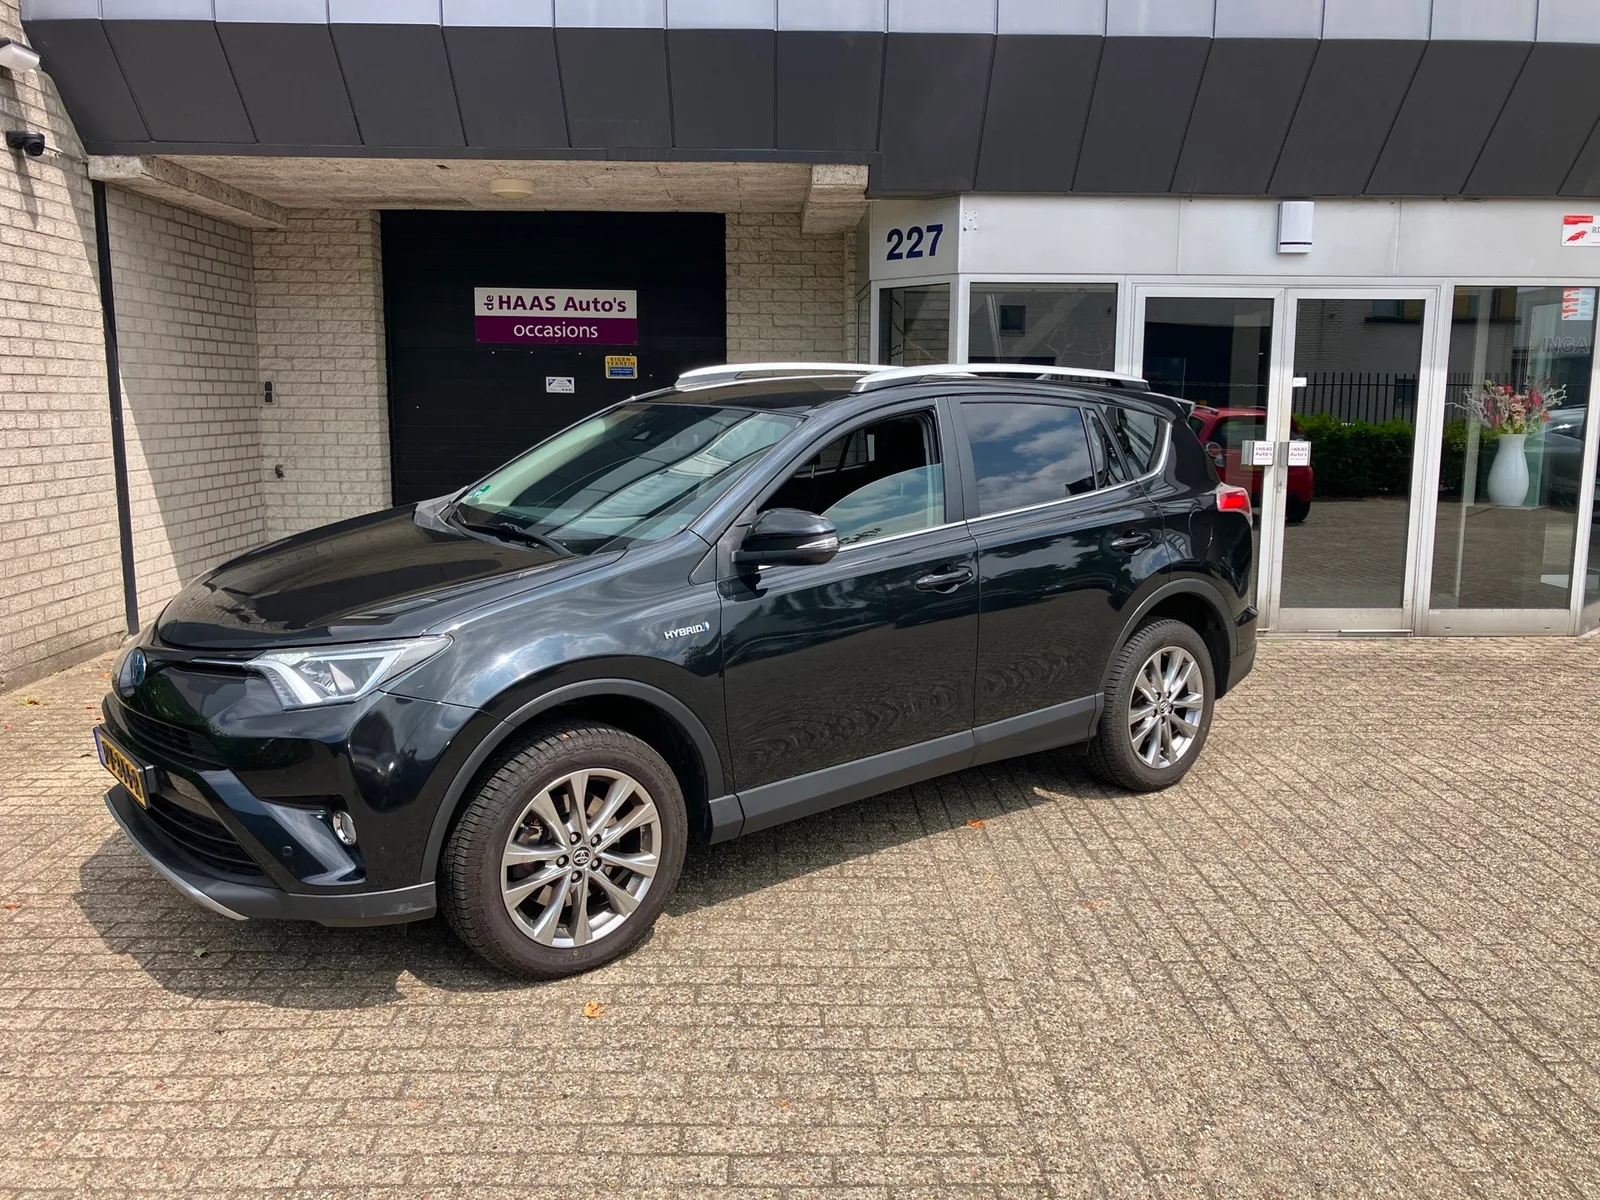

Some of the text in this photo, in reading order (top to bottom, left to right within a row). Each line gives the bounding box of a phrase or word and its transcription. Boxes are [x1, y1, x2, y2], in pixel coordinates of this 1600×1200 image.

[886, 223, 943, 261] 227
[484, 295, 627, 312] de HAAS Auto's
[513, 321, 599, 338] occasions
[664, 624, 703, 640] HYBRID
